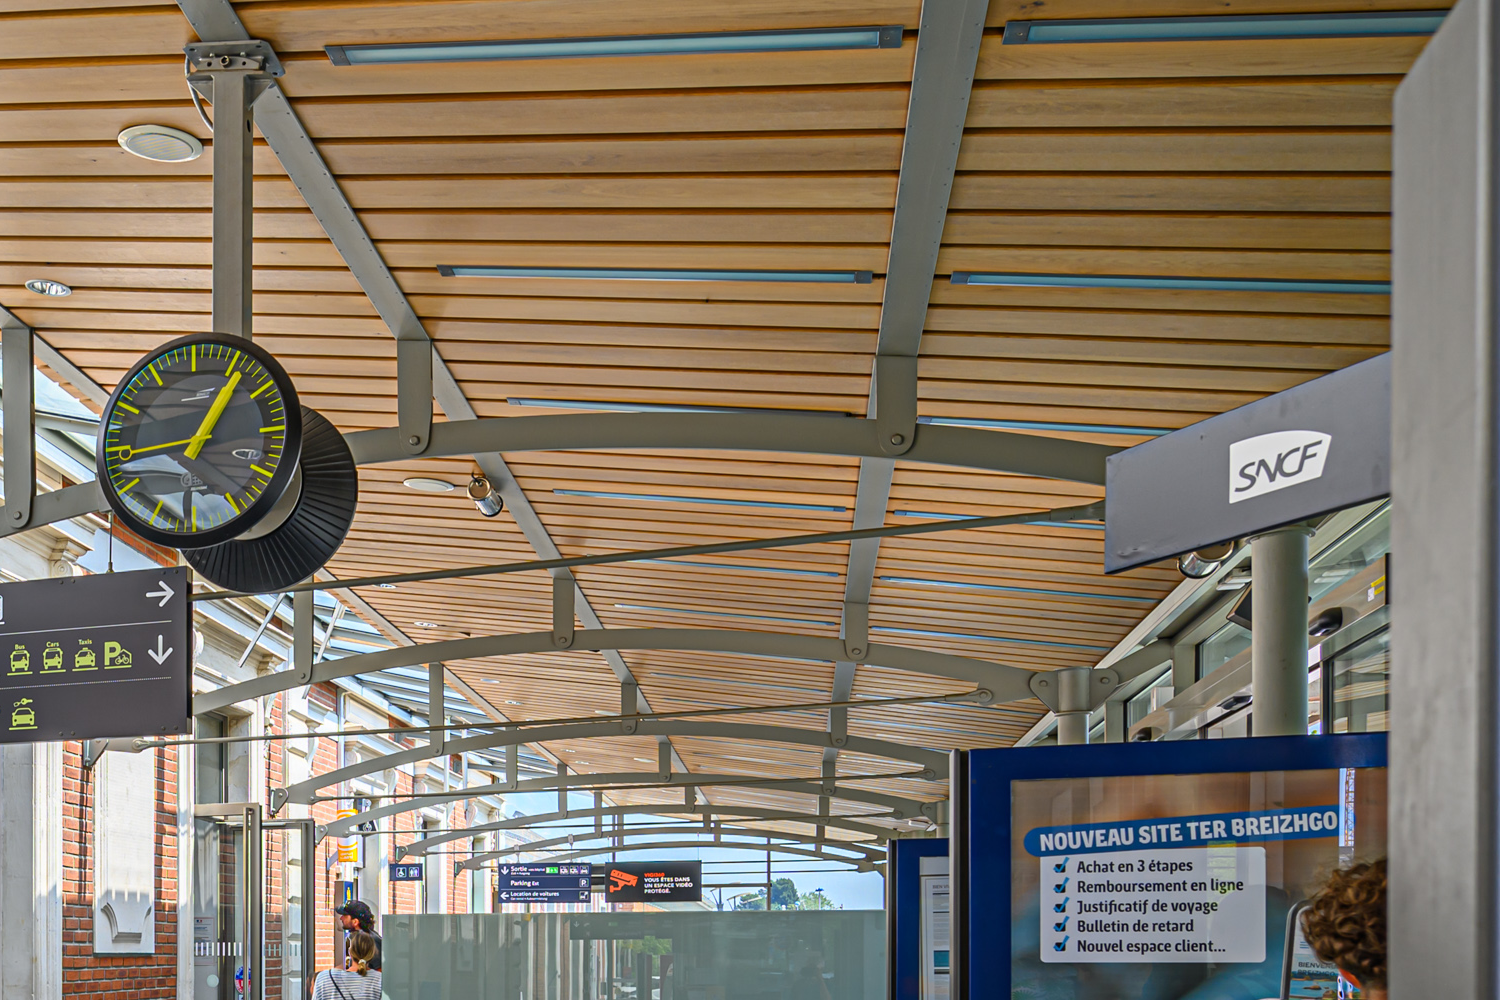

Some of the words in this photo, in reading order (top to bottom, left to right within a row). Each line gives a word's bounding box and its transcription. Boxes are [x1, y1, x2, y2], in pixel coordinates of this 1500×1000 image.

[1234, 439, 1323, 493] SNCF
[78, 638, 93, 646] Taxis
[1039, 826, 1134, 852] NOUVEAU
[1138, 822, 1183, 844] SITE
[1186, 819, 1227, 841] TER
[1231, 810, 1338, 838] BREIZHGO
[1077, 859, 1115, 873] Achat
[1117, 862, 1134, 873] en
[1137, 860, 1145, 873] 3
[1148, 859, 1193, 875] étapes
[1077, 880, 1188, 894] Remboursement
[1191, 882, 1207, 892] en
[1210, 878, 1244, 894] ligne
[1077, 899, 1148, 914] Justificatif
[1152, 900, 1168, 912] de
[1171, 901, 1218, 915] voyage
[1077, 919, 1129, 933] Bulletin
[1133, 920, 1149, 932] de
[1152, 919, 1194, 932] retard
[1077, 939, 1123, 953] Nouvel
[1126, 942, 1172, 956] espace
[1174, 939, 1226, 953] client...
